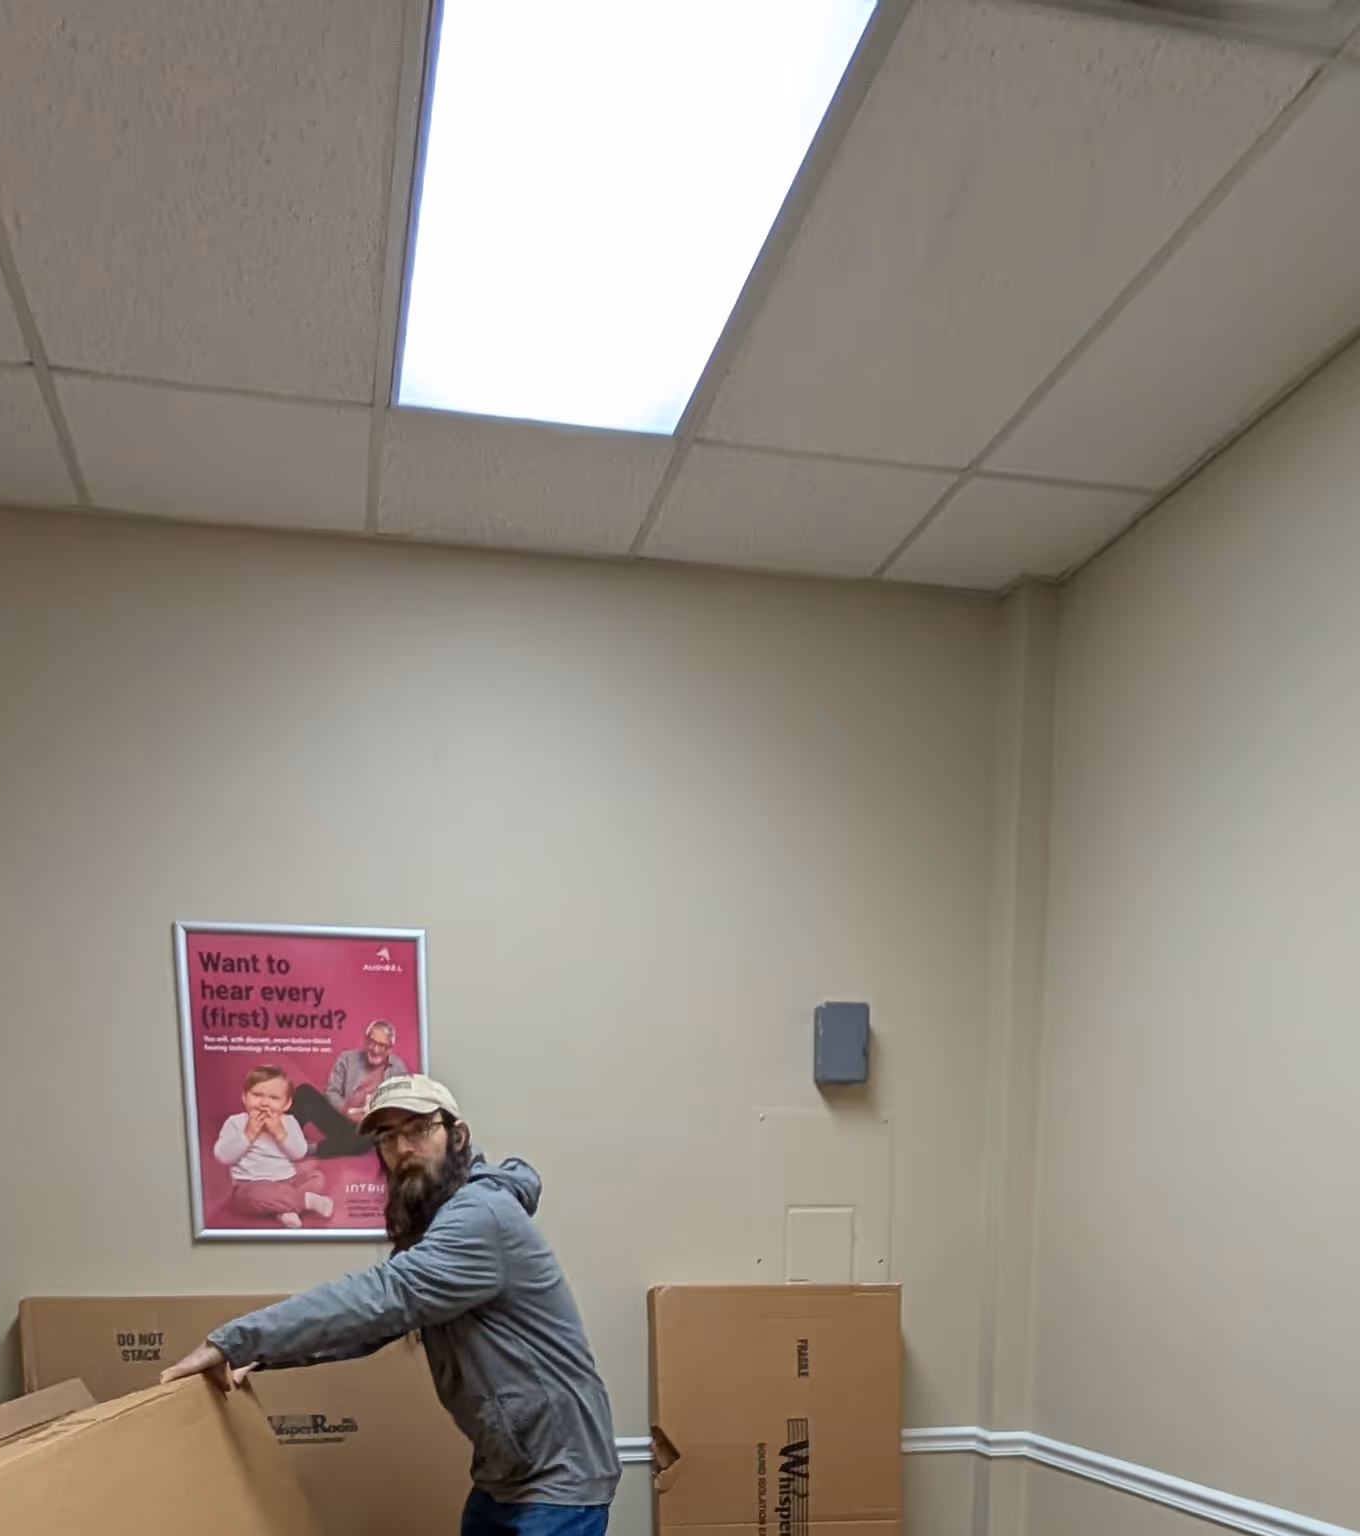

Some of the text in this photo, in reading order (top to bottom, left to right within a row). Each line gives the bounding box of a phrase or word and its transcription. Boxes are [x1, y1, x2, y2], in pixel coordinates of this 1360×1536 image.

[198, 952, 291, 975] Want to
[200, 980, 325, 1007] hear every
[201, 1005, 347, 1030] (first) word?
[116, 1332, 164, 1347] DO NOT
[121, 1348, 161, 1362] STACK
